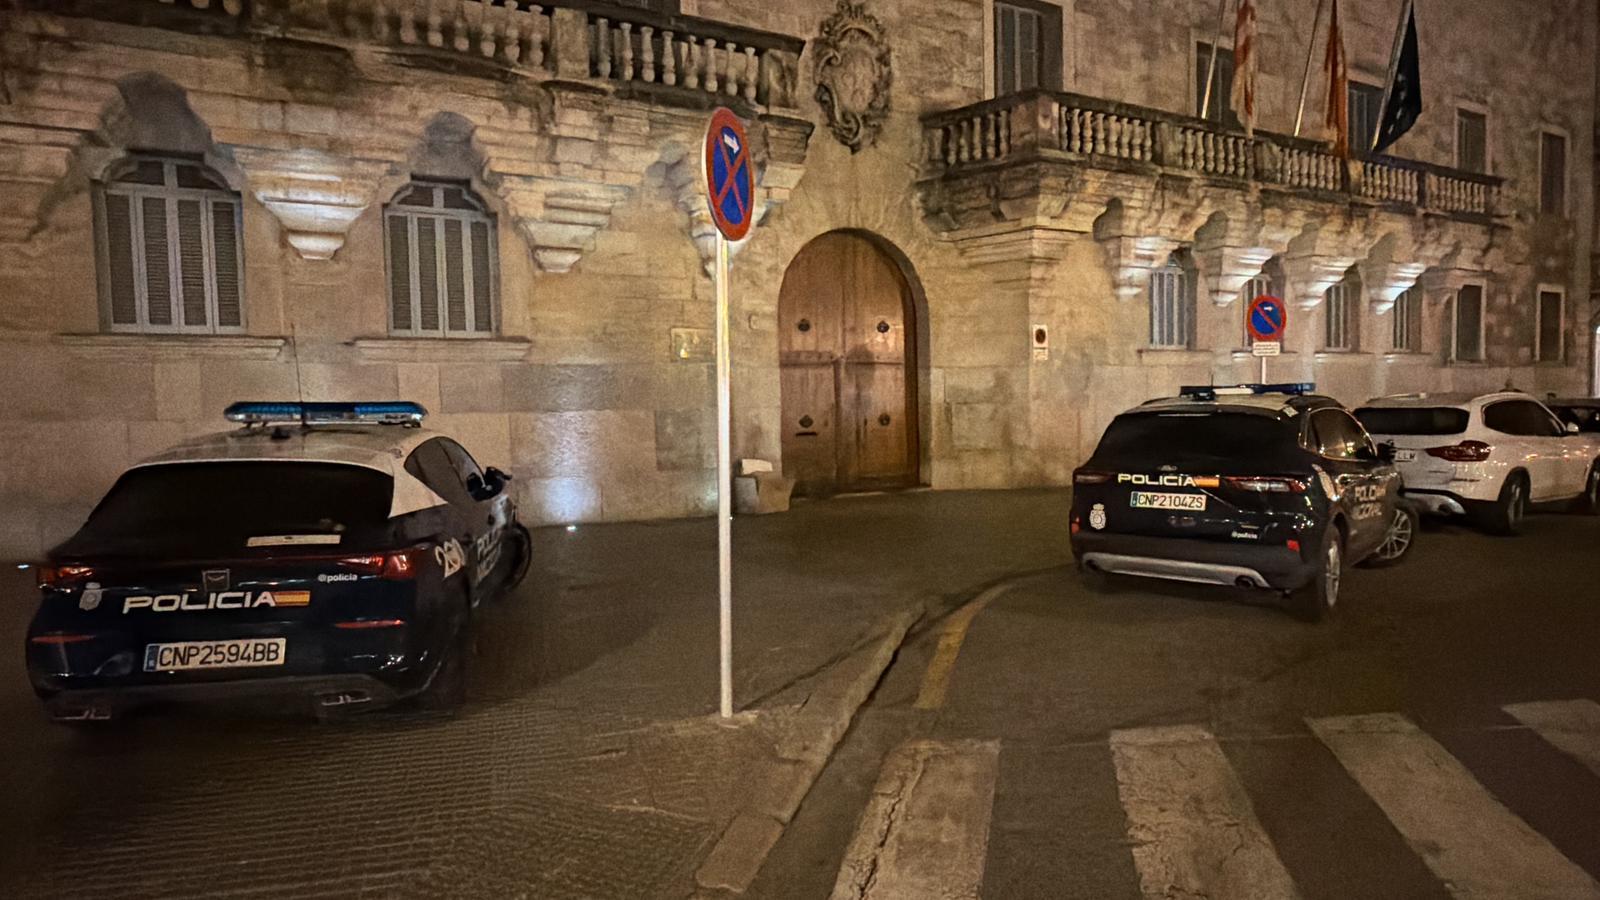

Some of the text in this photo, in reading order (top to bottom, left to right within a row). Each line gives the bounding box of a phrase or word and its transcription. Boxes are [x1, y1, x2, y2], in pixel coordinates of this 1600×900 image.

[1117, 473, 1196, 487] POLICIA
[1138, 494, 1203, 508] CNP2104ZS
[317, 573, 358, 584] @policia
[122, 591, 276, 614] POLICIA
[158, 642, 280, 667] CNP2594BB
